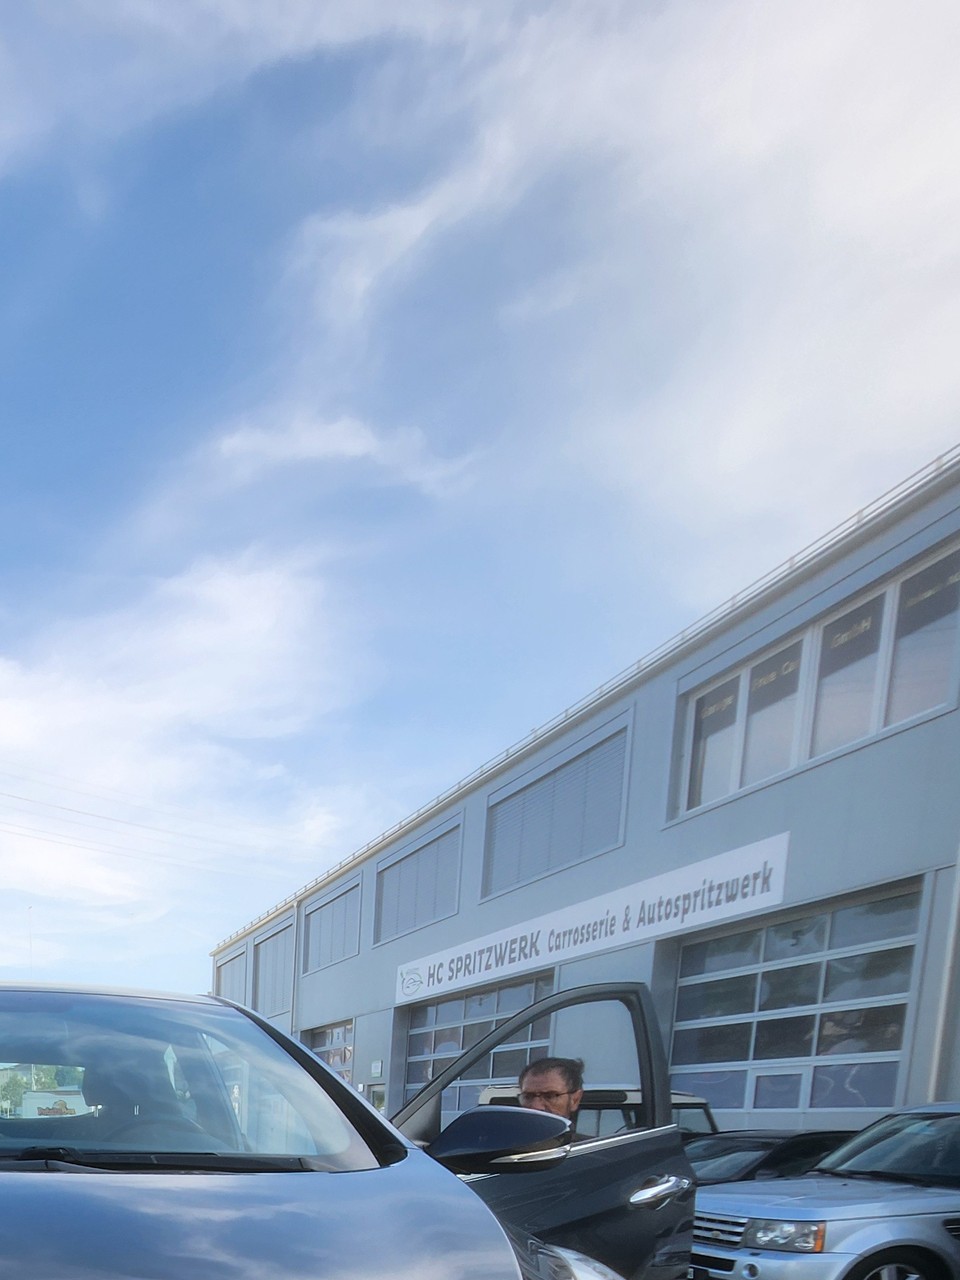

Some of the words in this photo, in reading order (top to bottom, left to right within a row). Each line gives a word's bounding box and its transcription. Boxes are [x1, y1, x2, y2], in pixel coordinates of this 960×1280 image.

[427, 962, 445, 987] HC
[448, 930, 541, 981] SPRITZWERK
[548, 909, 617, 953] Carrosserie
[622, 905, 632, 933] &
[636, 860, 773, 923] Autospritzwerk
